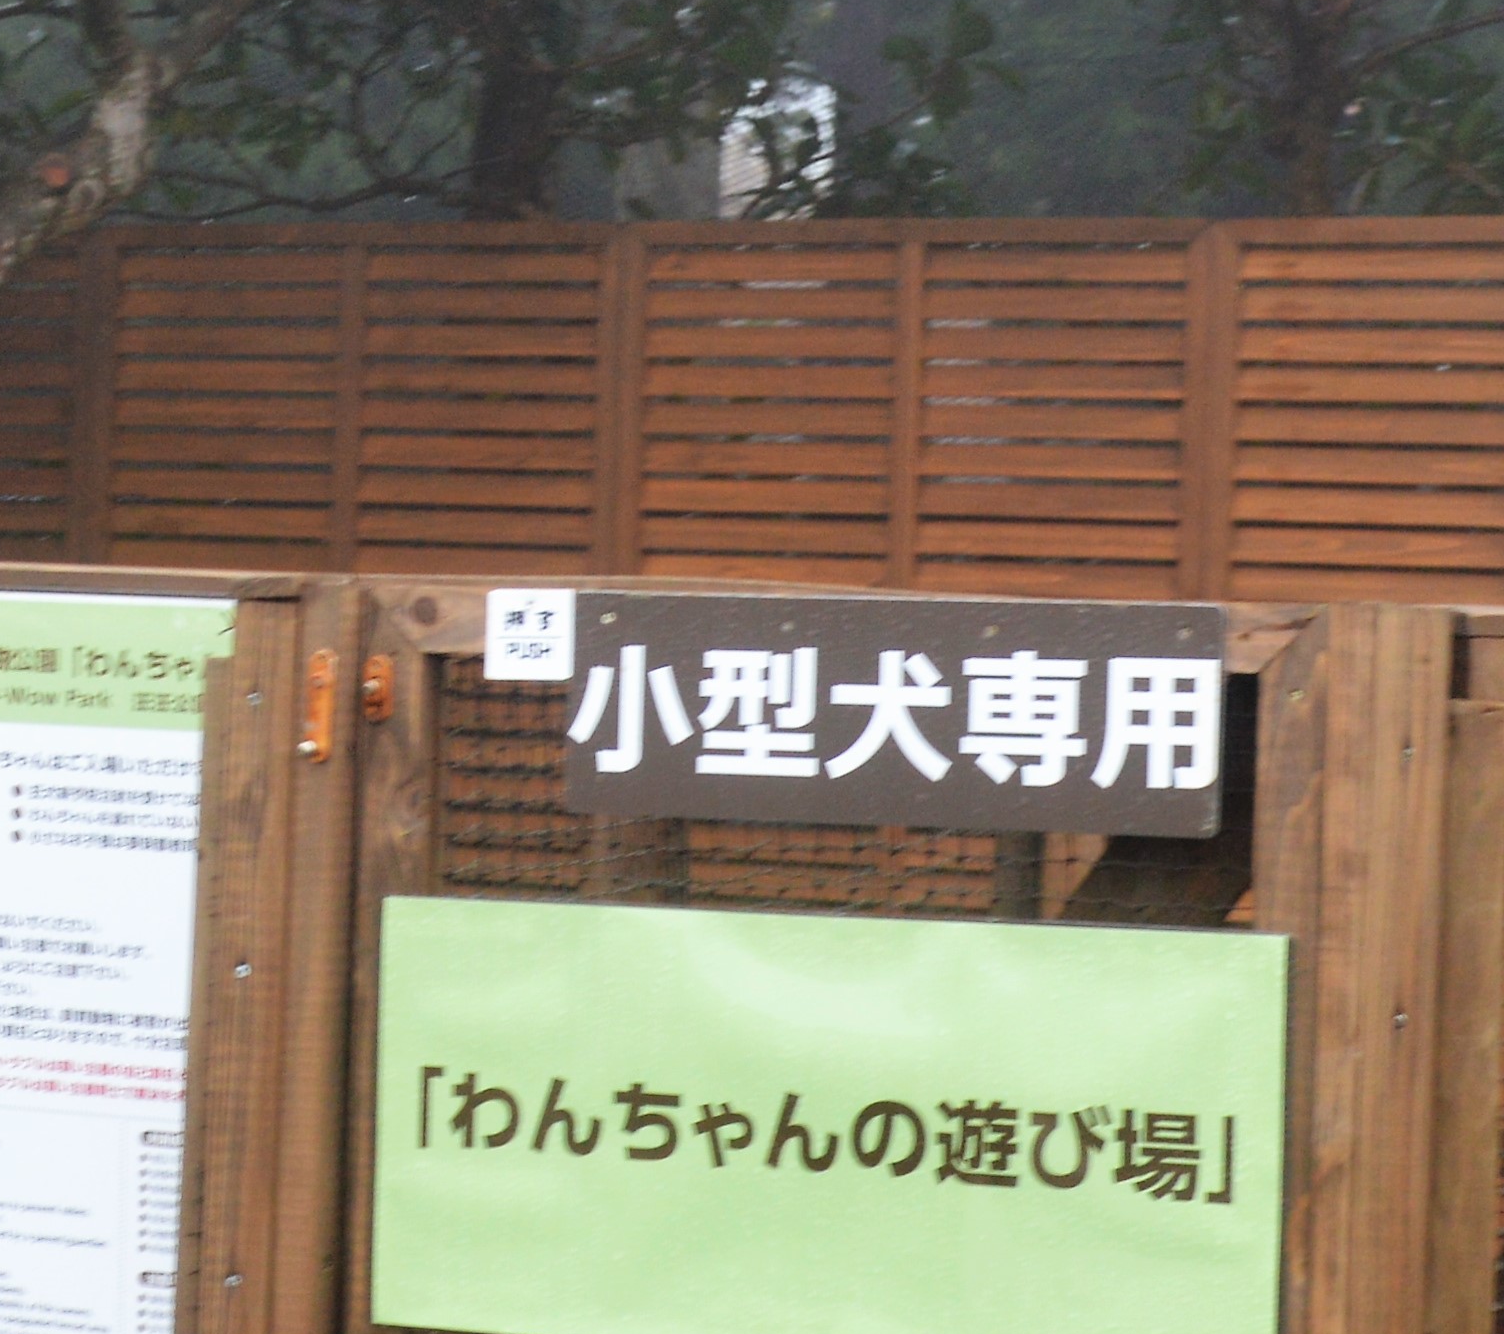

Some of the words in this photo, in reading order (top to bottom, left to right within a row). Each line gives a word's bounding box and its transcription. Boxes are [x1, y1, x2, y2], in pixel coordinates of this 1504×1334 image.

[566, 645, 1223, 791] 小型犬専用
[416, 1065, 1235, 1205] 「わんちゃんの遊び場」
